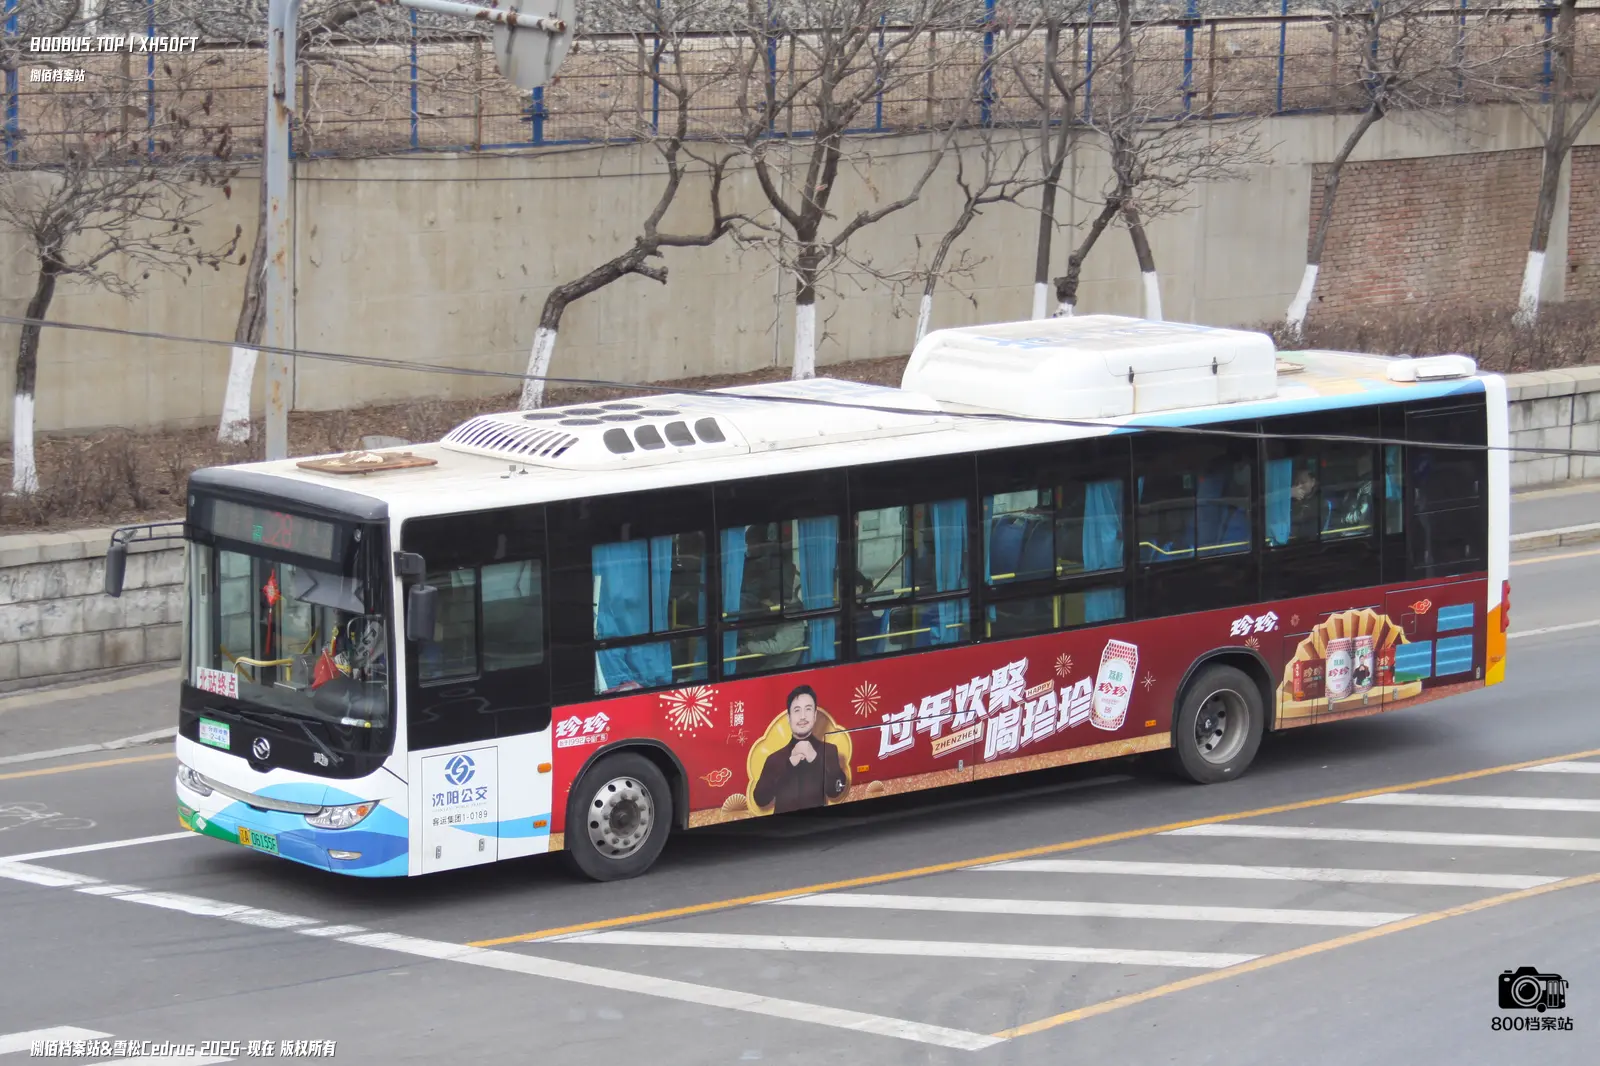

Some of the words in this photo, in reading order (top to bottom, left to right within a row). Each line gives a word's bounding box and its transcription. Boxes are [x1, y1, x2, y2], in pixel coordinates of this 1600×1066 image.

[1230, 611, 1279, 637] 珍珍
[1027, 682, 1051, 697] HAPPY
[1098, 681, 1128, 698] 珍珍
[733, 700, 744, 727] 沈腾
[878, 657, 1028, 760] 过年欢聚
[984, 676, 1095, 761] 喝珍珍
[555, 711, 610, 738] 珍珍
[935, 728, 979, 751] ZHENZHEN
[432, 786, 488, 807] 沈阳公交
